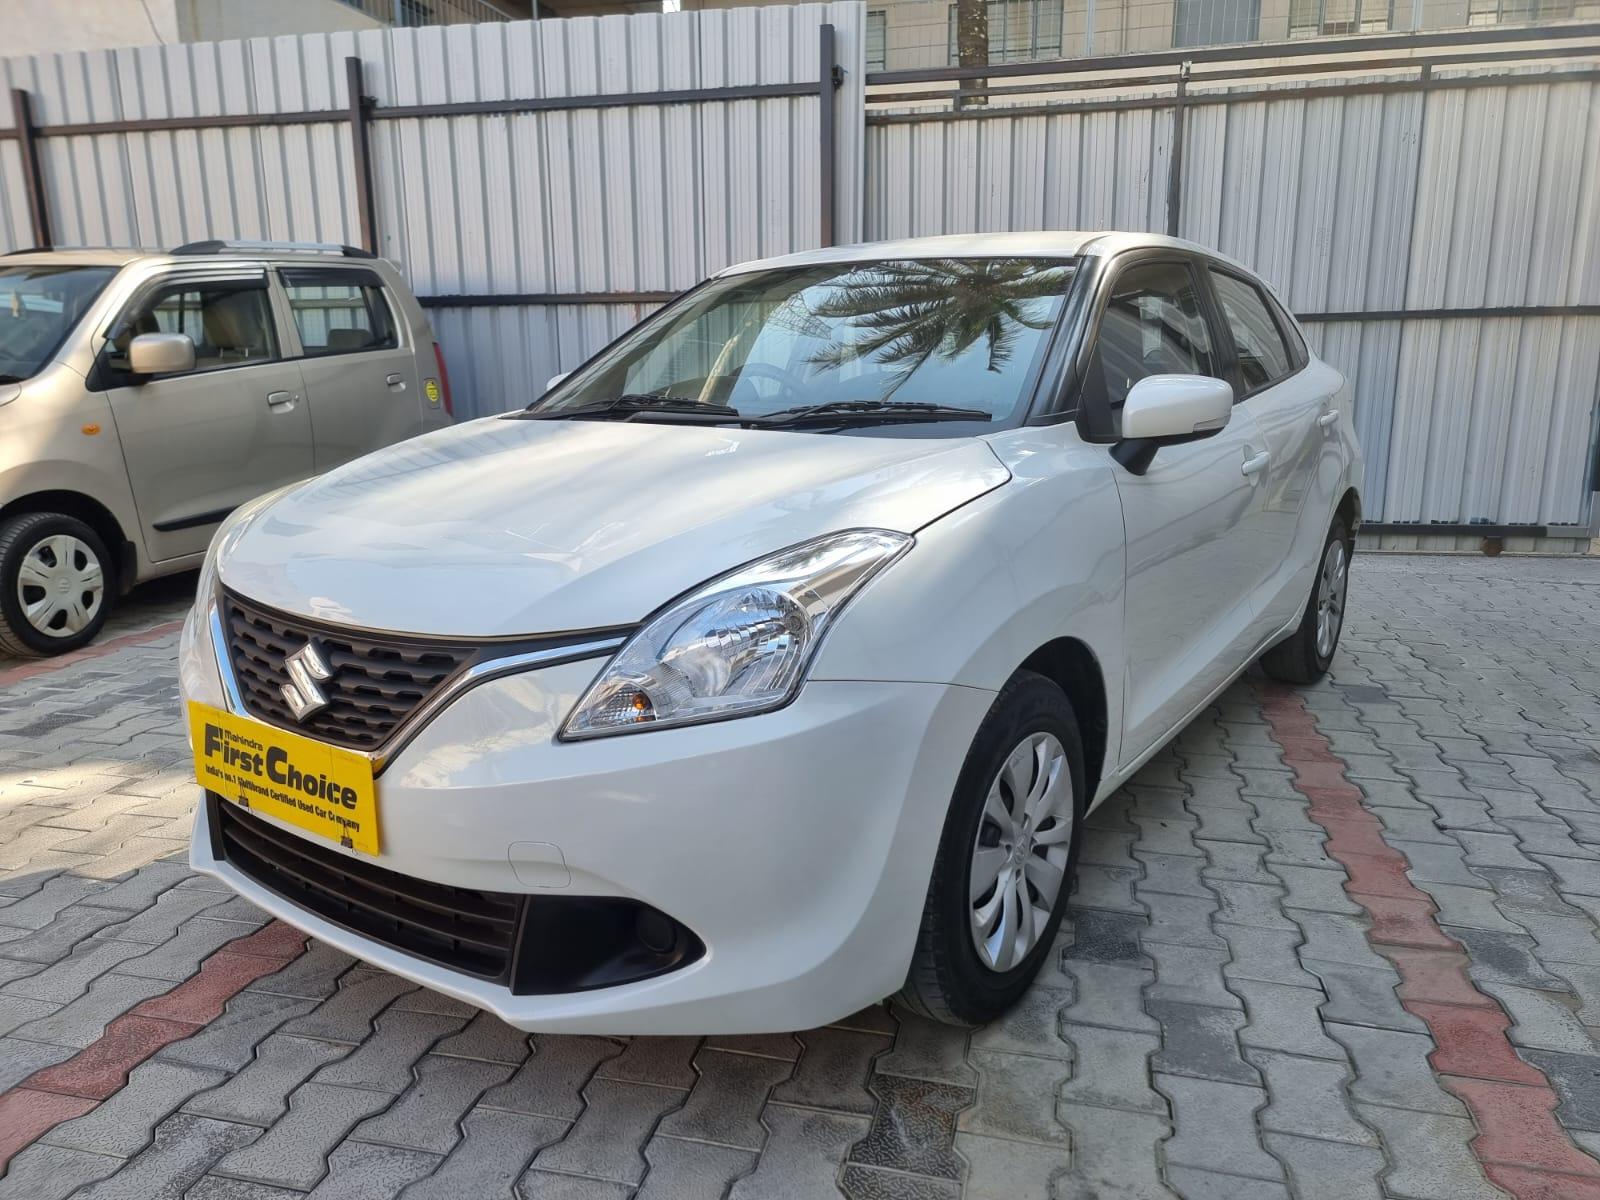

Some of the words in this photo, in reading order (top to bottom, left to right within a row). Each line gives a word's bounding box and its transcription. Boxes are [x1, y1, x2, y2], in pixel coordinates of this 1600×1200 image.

[224, 730, 264, 751] Mahindra
[205, 723, 264, 776] First
[266, 745, 358, 810] Choice
[269, 789, 297, 807] Certified
[297, 799, 314, 814] Used
[314, 806, 327, 818] Car
